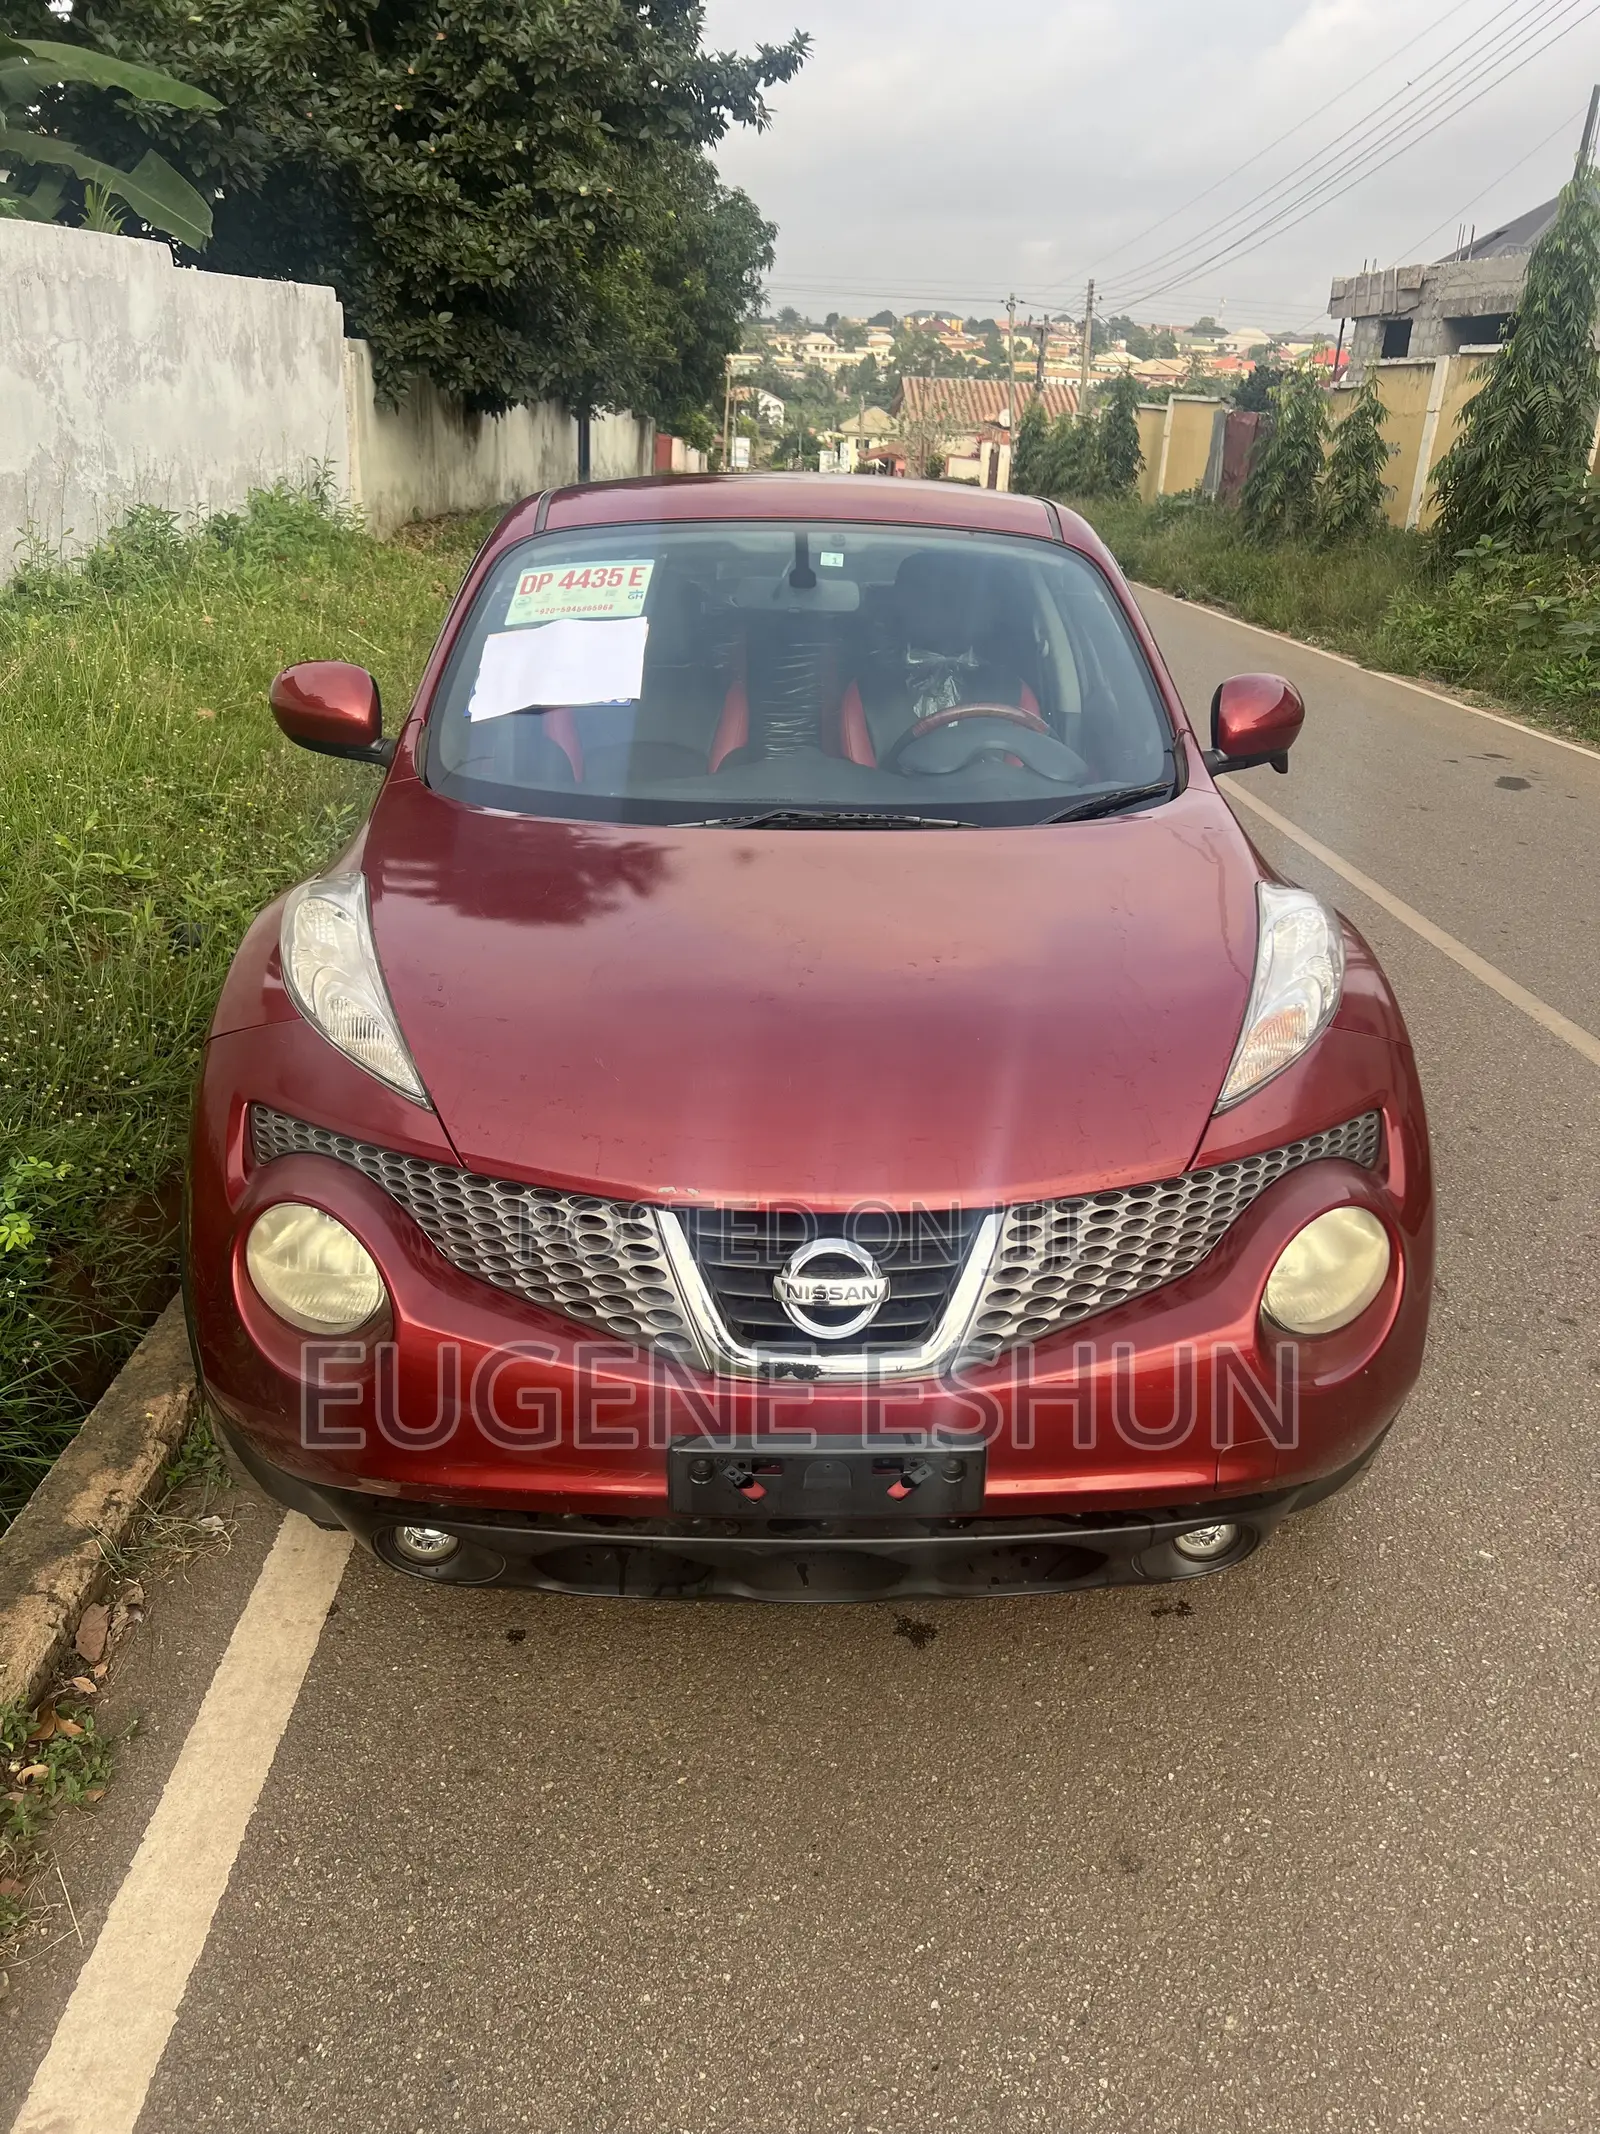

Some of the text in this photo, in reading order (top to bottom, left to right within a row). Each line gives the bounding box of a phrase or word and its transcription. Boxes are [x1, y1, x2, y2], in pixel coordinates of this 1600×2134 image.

[519, 567, 646, 595] DP 4435 E
[785, 1283, 879, 1302] NISSAN
